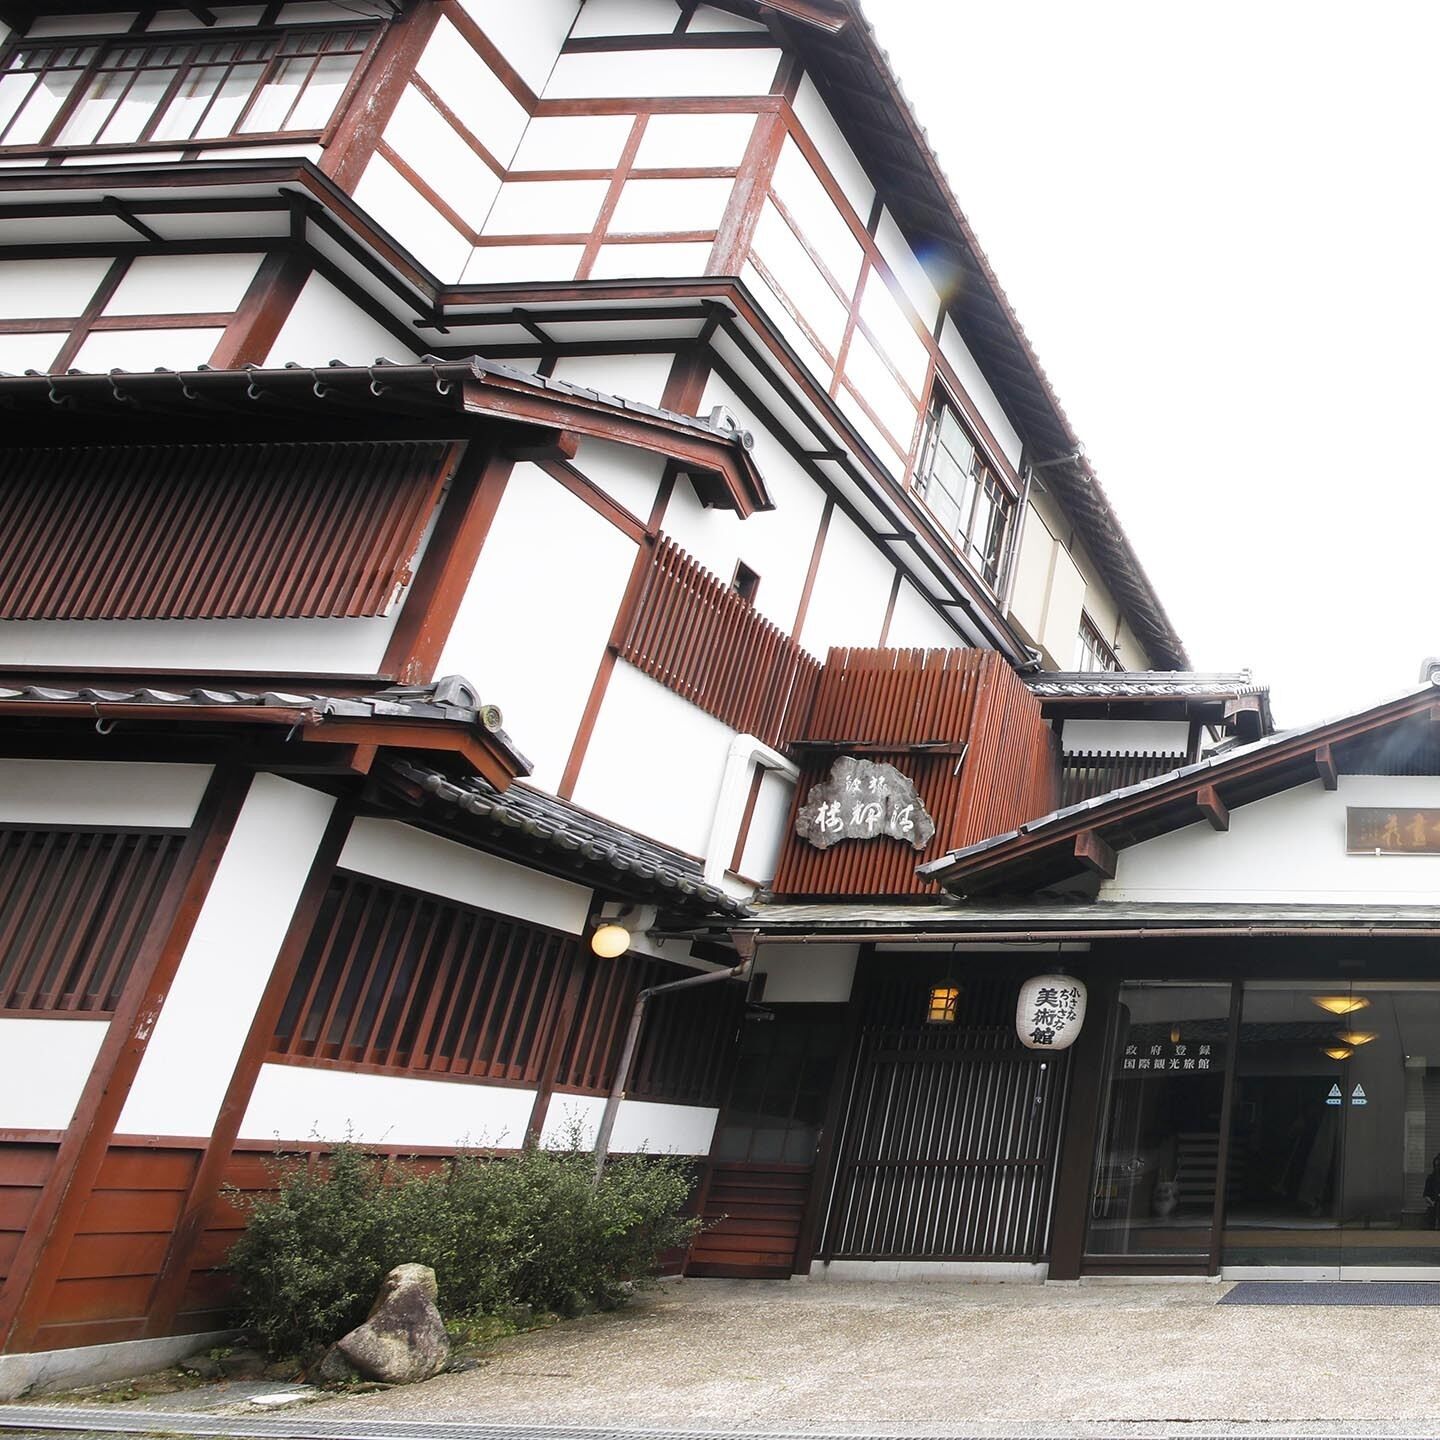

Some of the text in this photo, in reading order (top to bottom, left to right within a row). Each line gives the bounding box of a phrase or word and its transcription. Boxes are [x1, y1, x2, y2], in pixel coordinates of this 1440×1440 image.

[1029, 987, 1059, 1045] 美術館
[1052, 988, 1070, 1031] ちいさな
[1066, 986, 1081, 1022] 小さな
[1123, 1058, 1210, 1070] 国際観光旅館
[1125, 1044, 1211, 1056] 政府登録
